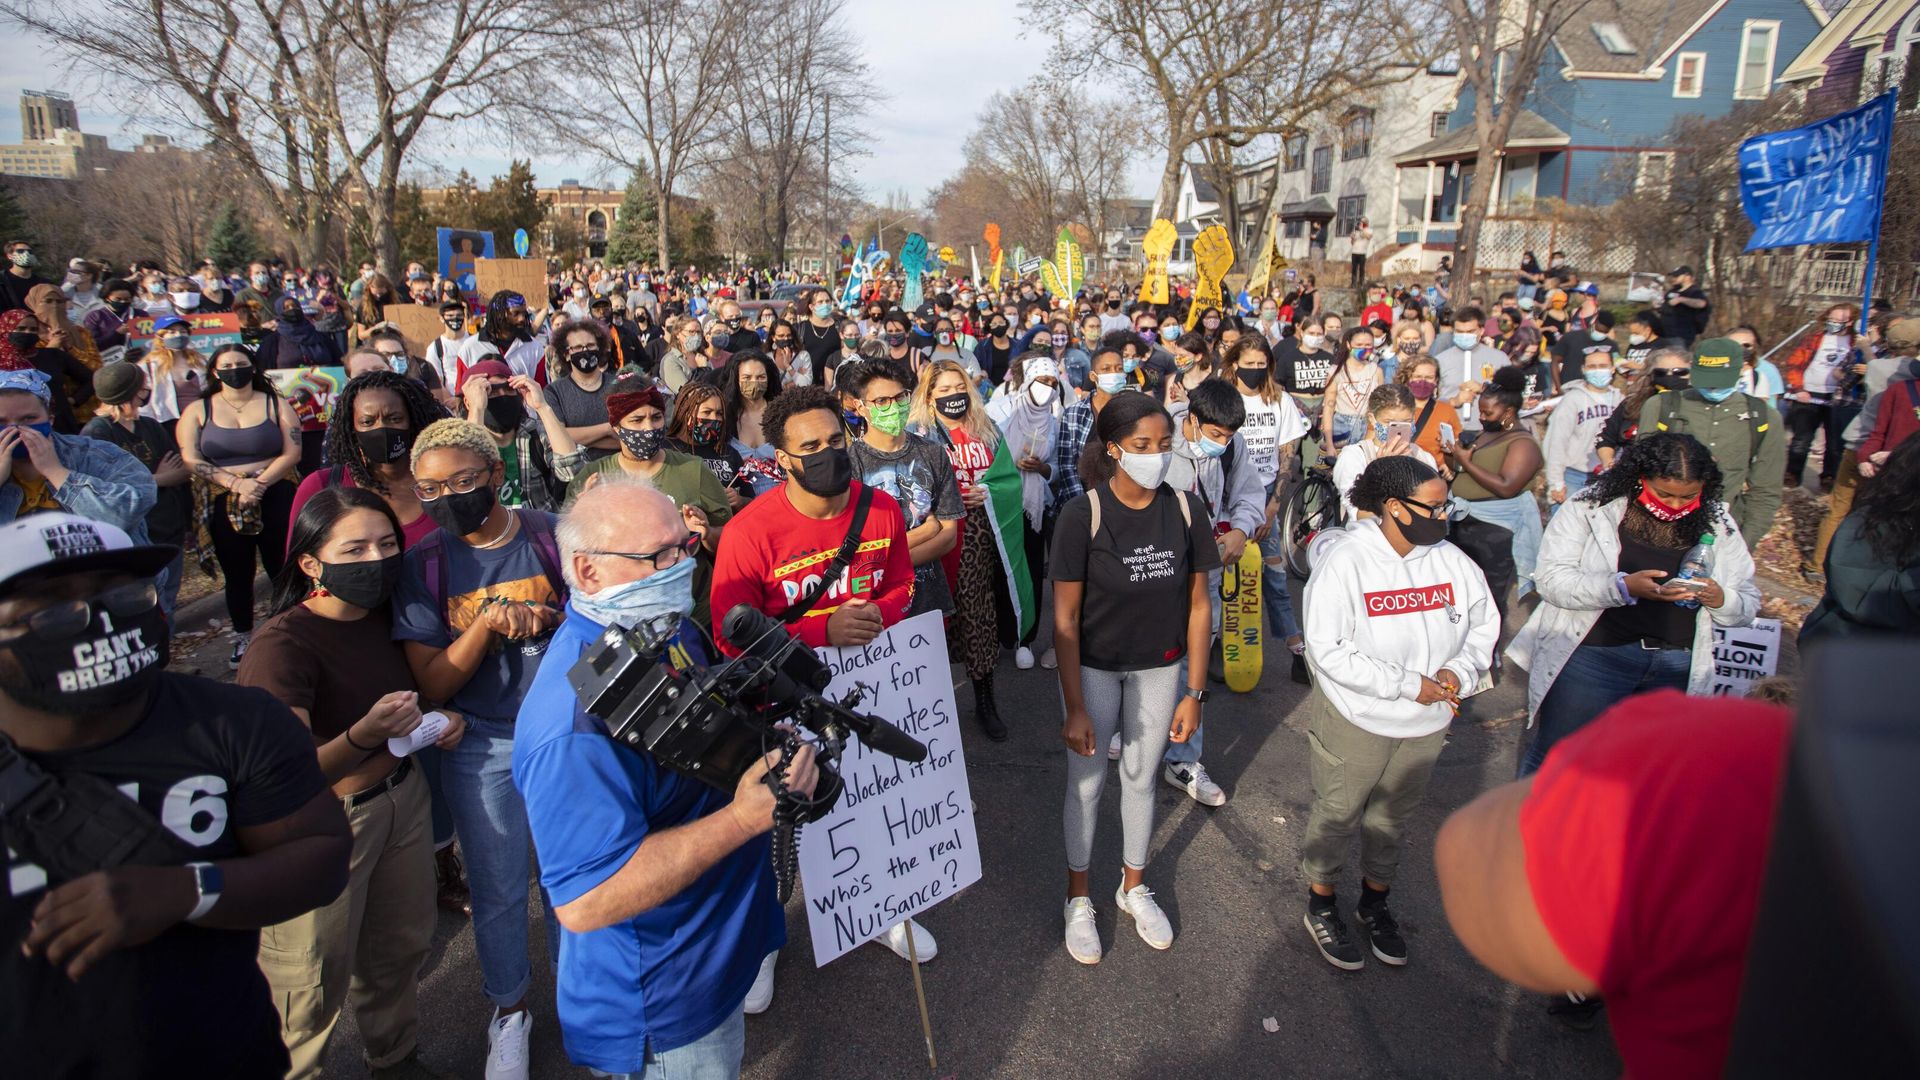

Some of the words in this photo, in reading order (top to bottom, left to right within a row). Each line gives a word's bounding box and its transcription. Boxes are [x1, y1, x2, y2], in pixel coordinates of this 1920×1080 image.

[1069, 242, 1083, 280] GREEN
[1150, 253, 1166, 262] FAIR
[1294, 359, 1331, 370] BLACK
[1299, 369, 1329, 379] LIVES
[1295, 379, 1327, 390] MATTE
[949, 399, 966, 408] CAN'T
[1257, 411, 1276, 427] MATTER
[1255, 437, 1275, 446] MATTER
[1256, 446, 1275, 455] MATTER
[45, 522, 98, 539] BLACK
[56, 534, 100, 550] LIVES
[1134, 544, 1155, 555] NEVER
[1122, 550, 1175, 565] UNDERESTIMATE
[1131, 564, 1145, 573] THE
[1147, 559, 1170, 570] POWER
[1130, 572, 1140, 582] OF
[1141, 572, 1147, 581] A
[1147, 566, 1174, 579] WOMAN
[782, 565, 885, 607] POWER
[1241, 569, 1259, 614] PEACE
[1369, 592, 1418, 612] GOD'S
[1417, 587, 1451, 607] PLAN
[99, 610, 114, 634] I
[1242, 627, 1259, 646] NO
[73, 627, 146, 669] CAN'T
[823, 630, 897, 678] blocked
[909, 633, 930, 650] a
[1225, 643, 1240, 662] NO
[57, 643, 160, 693] BREATHE
[890, 662, 928, 692] for
[843, 756, 904, 809] blocked
[909, 761, 924, 779] it
[927, 737, 957, 772] for
[827, 817, 860, 879] 5
[883, 789, 966, 847] Hours.
[813, 872, 873, 915] who's
[886, 855, 920, 881] the
[929, 828, 963, 863] real
